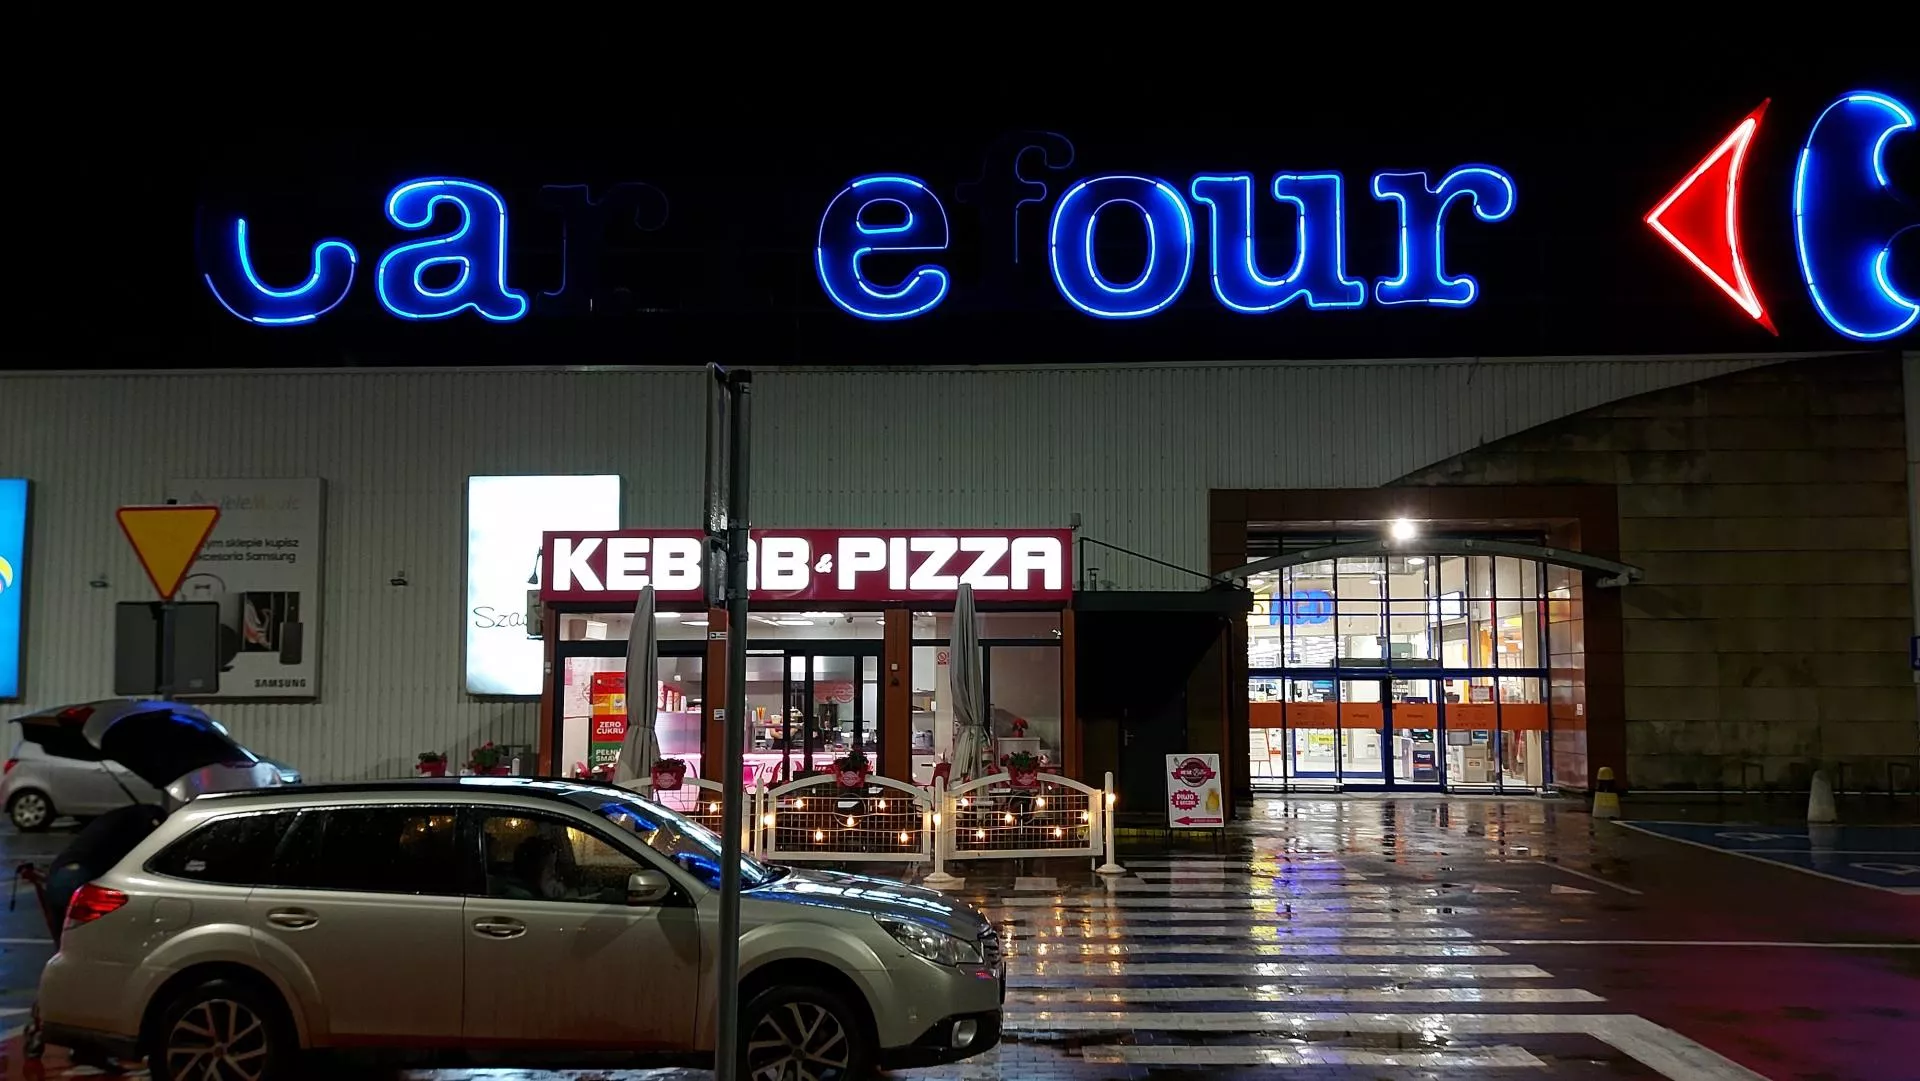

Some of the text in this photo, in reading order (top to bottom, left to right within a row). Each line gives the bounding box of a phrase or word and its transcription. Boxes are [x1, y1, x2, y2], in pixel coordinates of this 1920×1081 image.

[225, 538, 263, 550] sklepie
[265, 538, 299, 550] kupisz
[246, 552, 296, 564] Samsung
[553, 537, 1062, 591] KEBB & PIZZA
[254, 679, 306, 688] SAMSUNG
